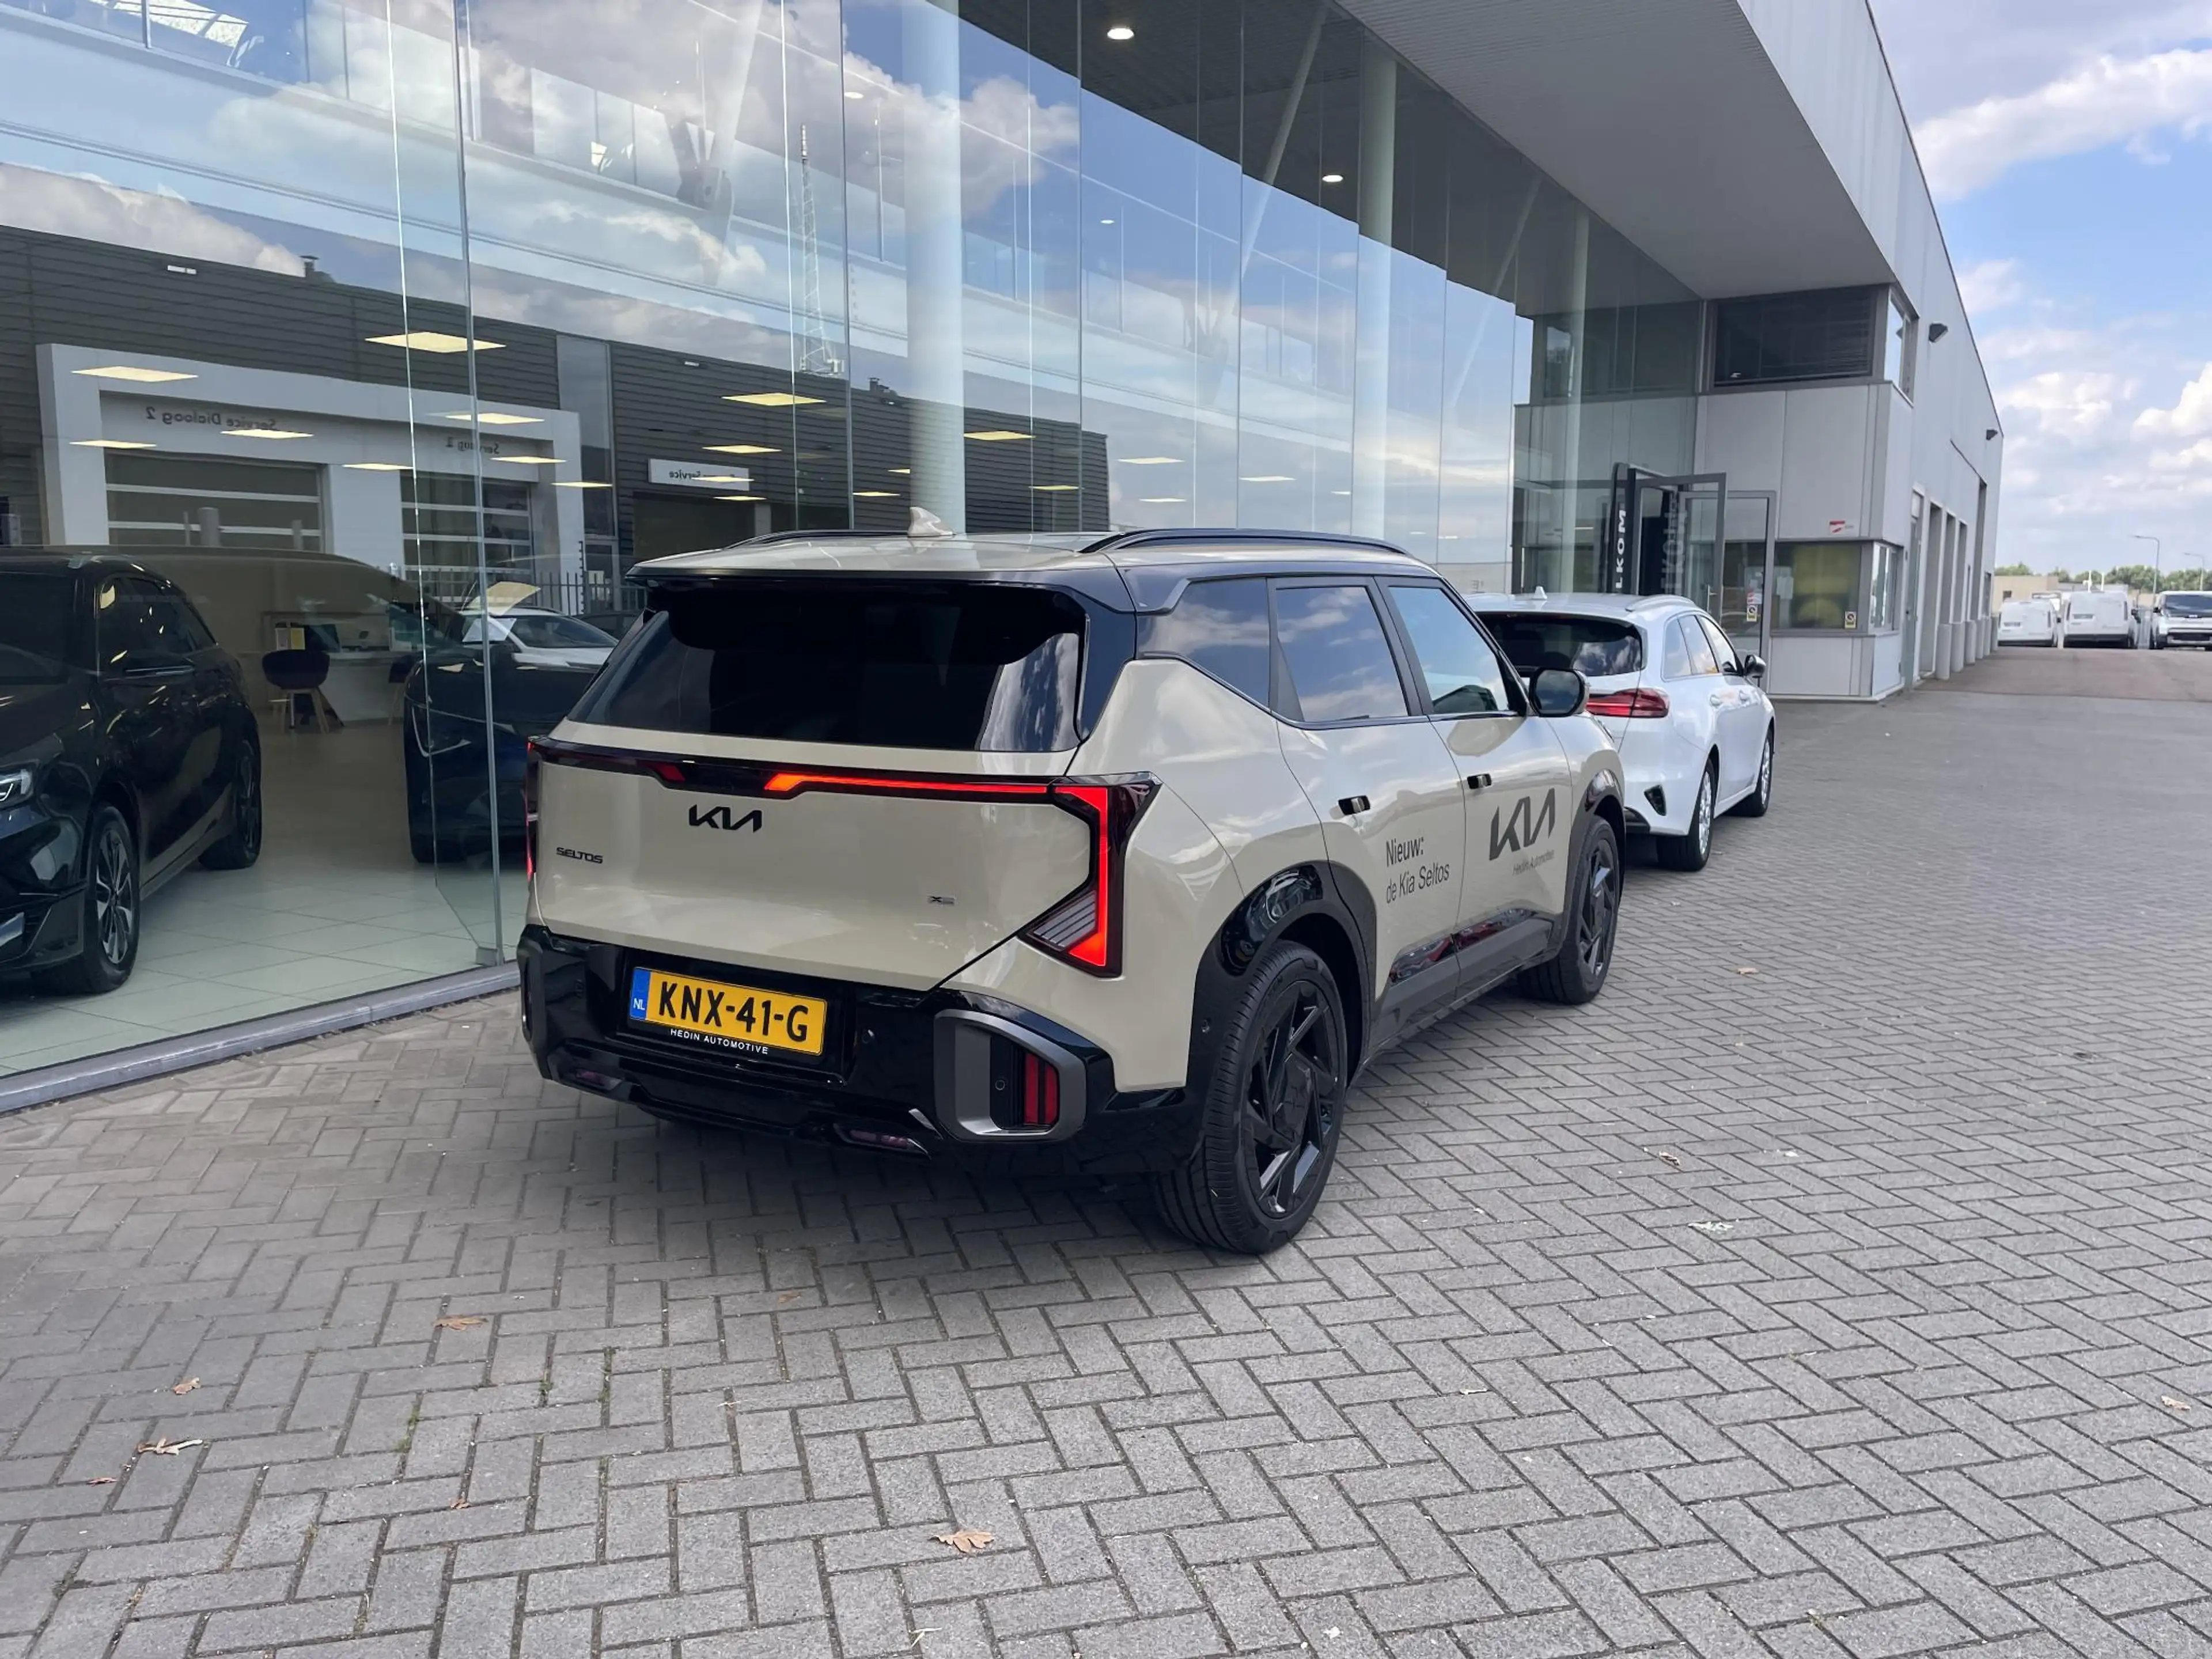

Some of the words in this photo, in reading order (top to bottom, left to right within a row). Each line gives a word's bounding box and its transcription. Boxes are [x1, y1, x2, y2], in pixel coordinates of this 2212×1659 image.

[689, 804, 762, 833] KIA
[1489, 787, 1555, 861] KIA
[556, 847, 603, 864] SELTOS
[1386, 836, 1423, 868] Nieuw:
[1387, 878, 1397, 904] de
[1399, 870, 1415, 897] Kia
[1418, 862, 1449, 889] Seltos
[633, 998, 645, 1011] NL
[659, 981, 809, 1042] KNX-41-G
[671, 1028, 700, 1040] HEDIN
[703, 1035, 768, 1054] AUTOMOTIVE
